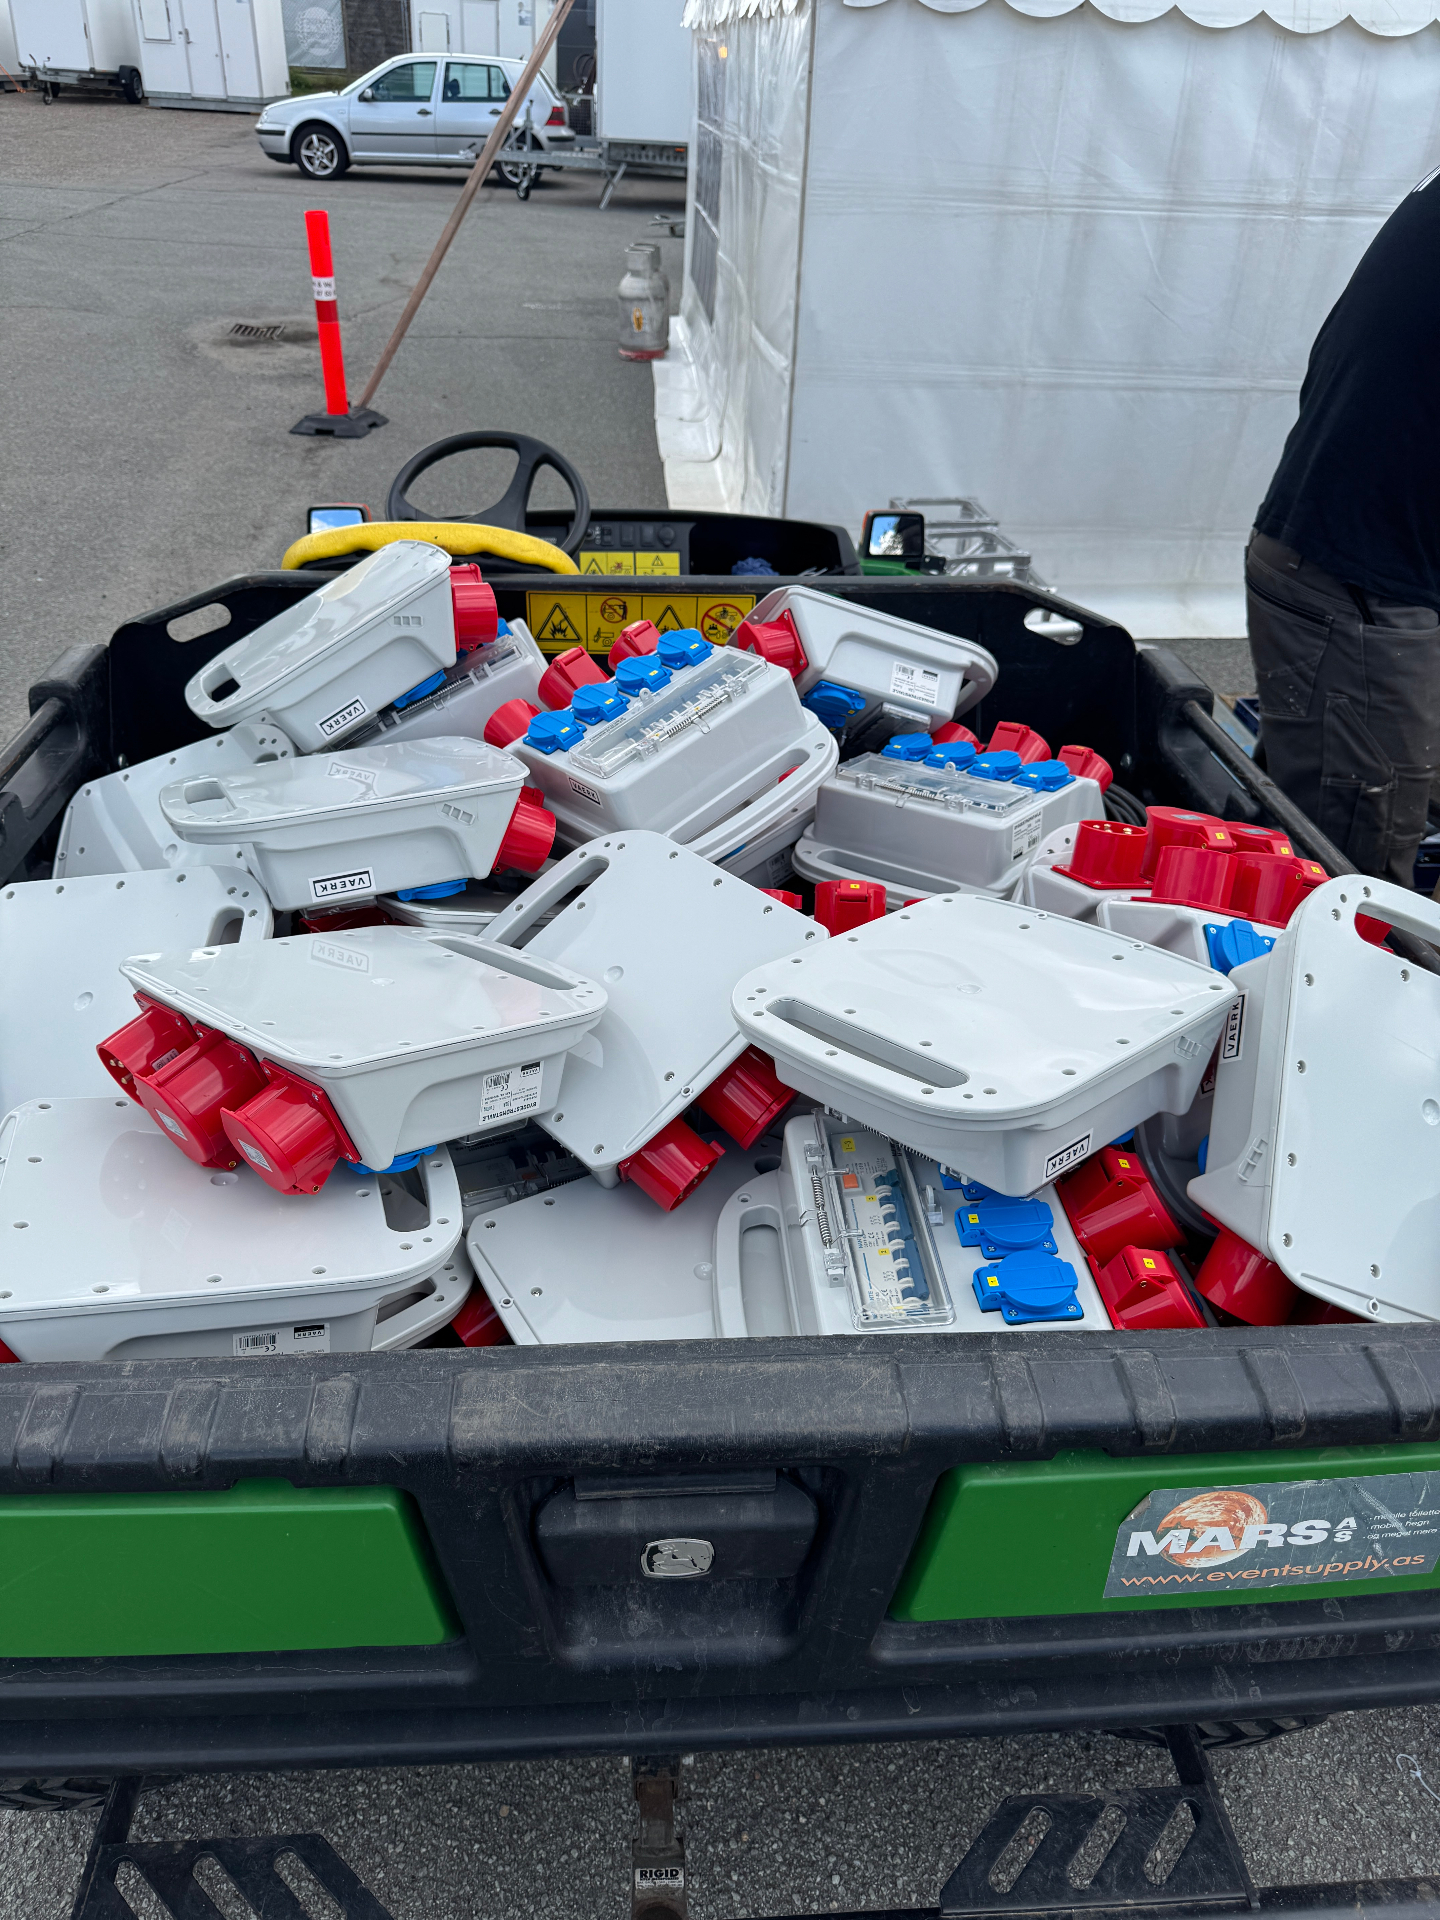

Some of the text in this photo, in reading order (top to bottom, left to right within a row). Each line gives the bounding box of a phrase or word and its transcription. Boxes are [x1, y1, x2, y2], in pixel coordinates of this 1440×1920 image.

[326, 706, 360, 730] VAERK
[572, 782, 598, 800] VAERK
[320, 877, 366, 892] VAERK
[1226, 1001, 1240, 1053] VAERK
[1050, 1143, 1085, 1171] VAERK
[297, 1330, 322, 1338] VAERK
[1126, 1519, 1332, 1557] MARS
[1412, 1528, 1438, 1536] mere
[1120, 1554, 1426, 1587] www.eventsupply.as
[640, 1868, 680, 1878] RIGID
